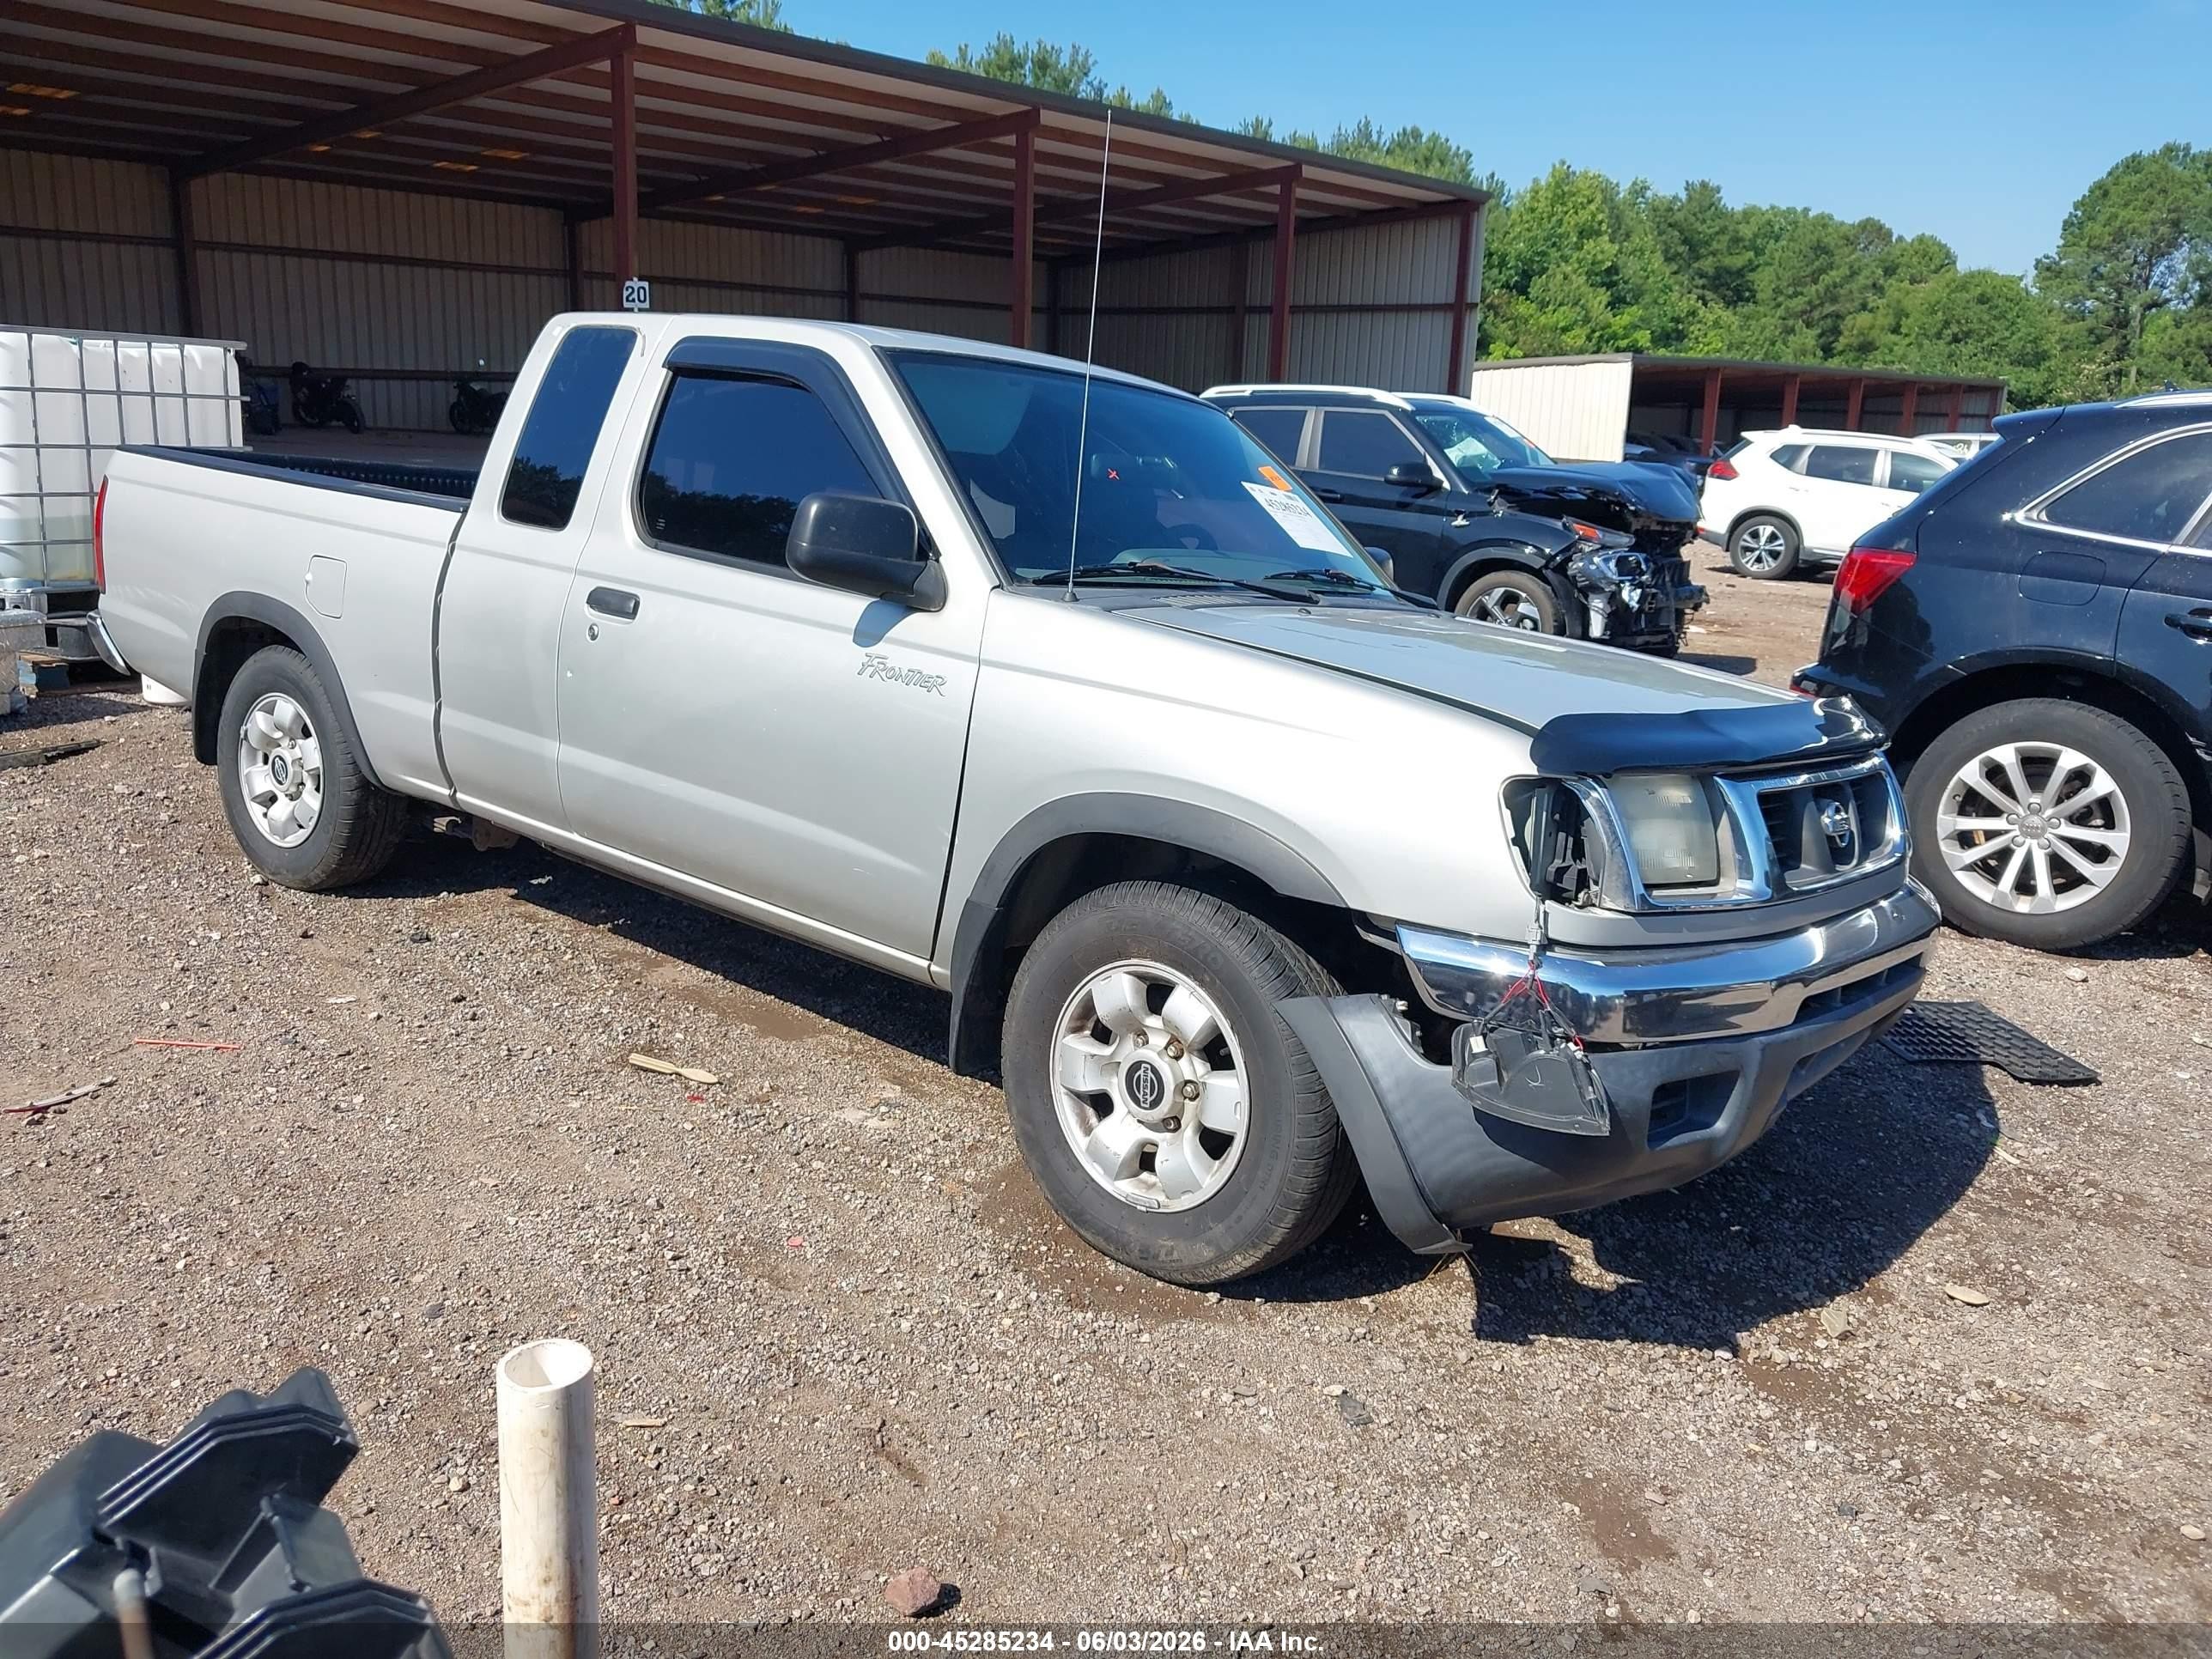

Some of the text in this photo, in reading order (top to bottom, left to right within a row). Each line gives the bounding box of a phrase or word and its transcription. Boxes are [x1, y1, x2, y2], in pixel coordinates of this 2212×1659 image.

[625, 285, 647, 304] 20
[857, 652, 948, 697] FRONTIER
[1141, 1066, 1150, 1105] NISSAN
